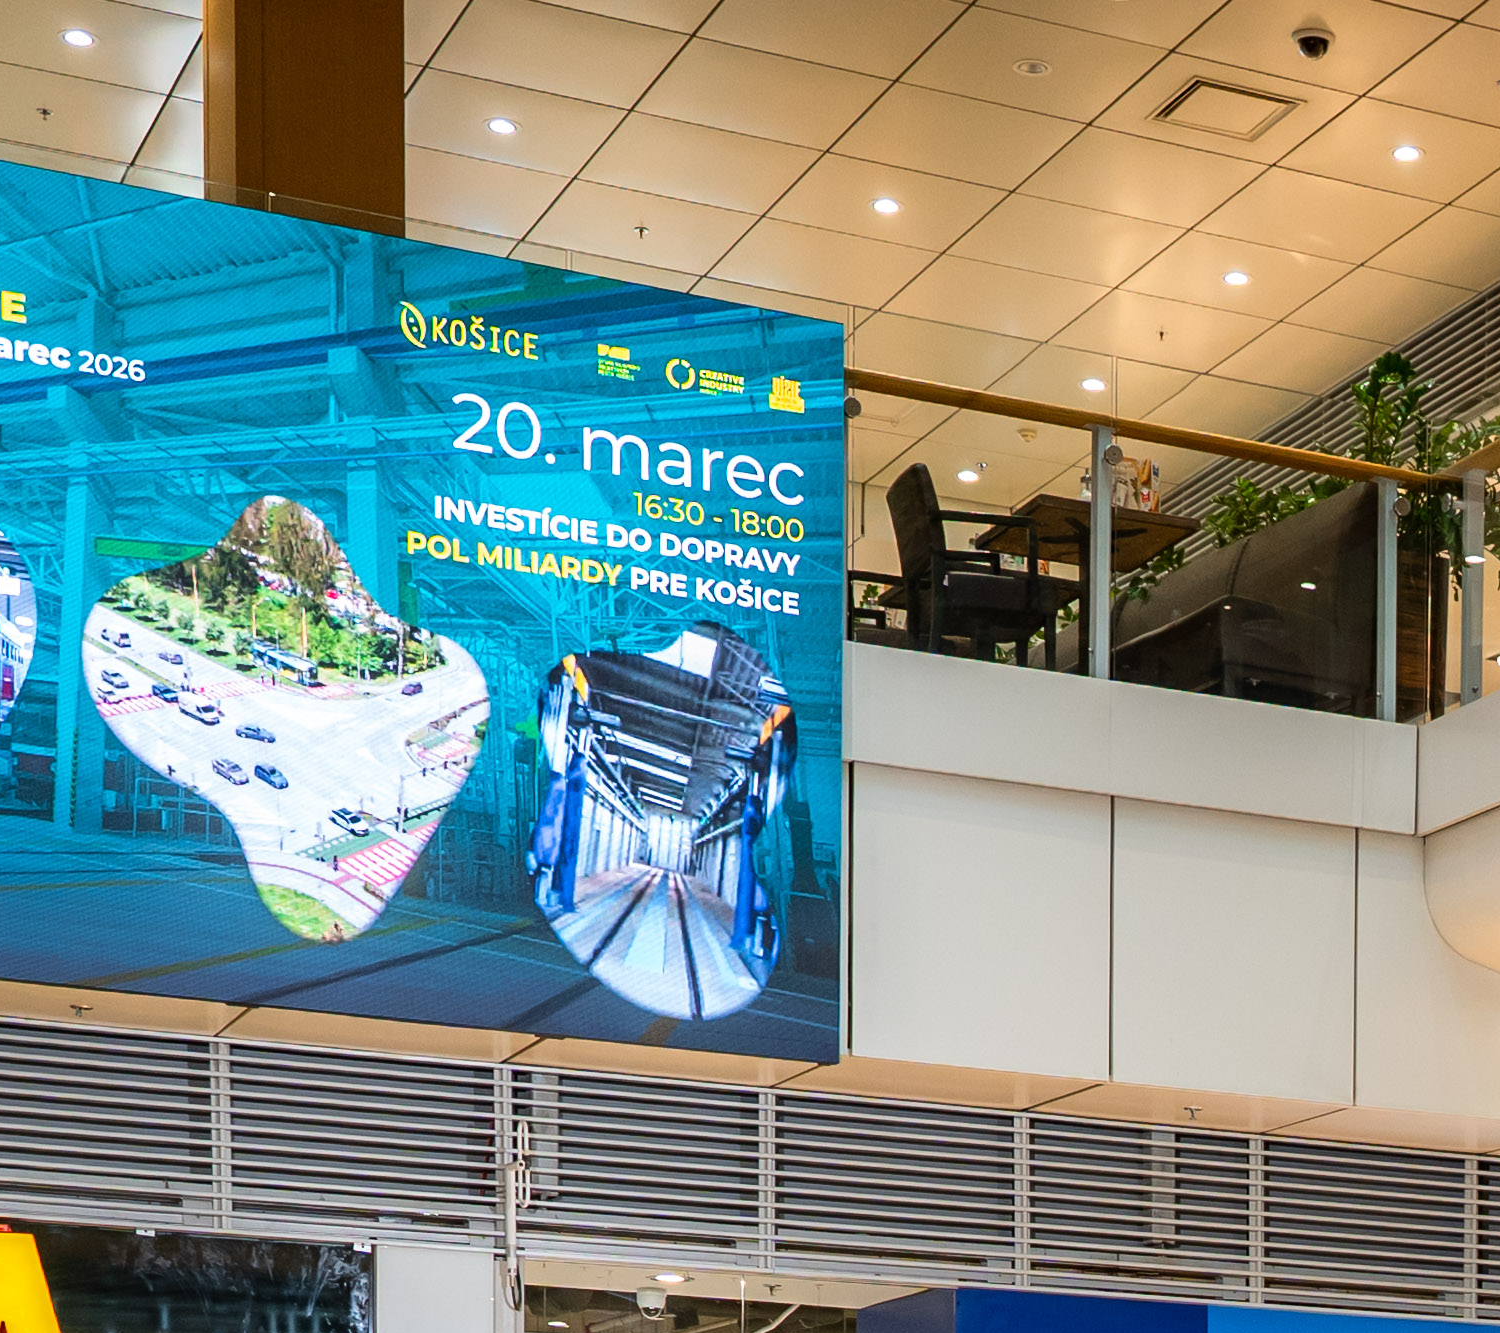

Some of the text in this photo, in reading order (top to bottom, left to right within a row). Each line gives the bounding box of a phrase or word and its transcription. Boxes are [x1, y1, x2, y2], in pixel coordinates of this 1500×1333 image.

[78, 350, 146, 382] 2026
[432, 315, 539, 360] KOŠICE
[452, 393, 805, 506] 20. marec
[434, 495, 801, 577] INVESTÍCIE DO DOPRAVY
[632, 491, 705, 527] 16:30
[730, 509, 805, 543] 18:00
[407, 531, 800, 615] POL MILIARDY PRE KOŠICE
